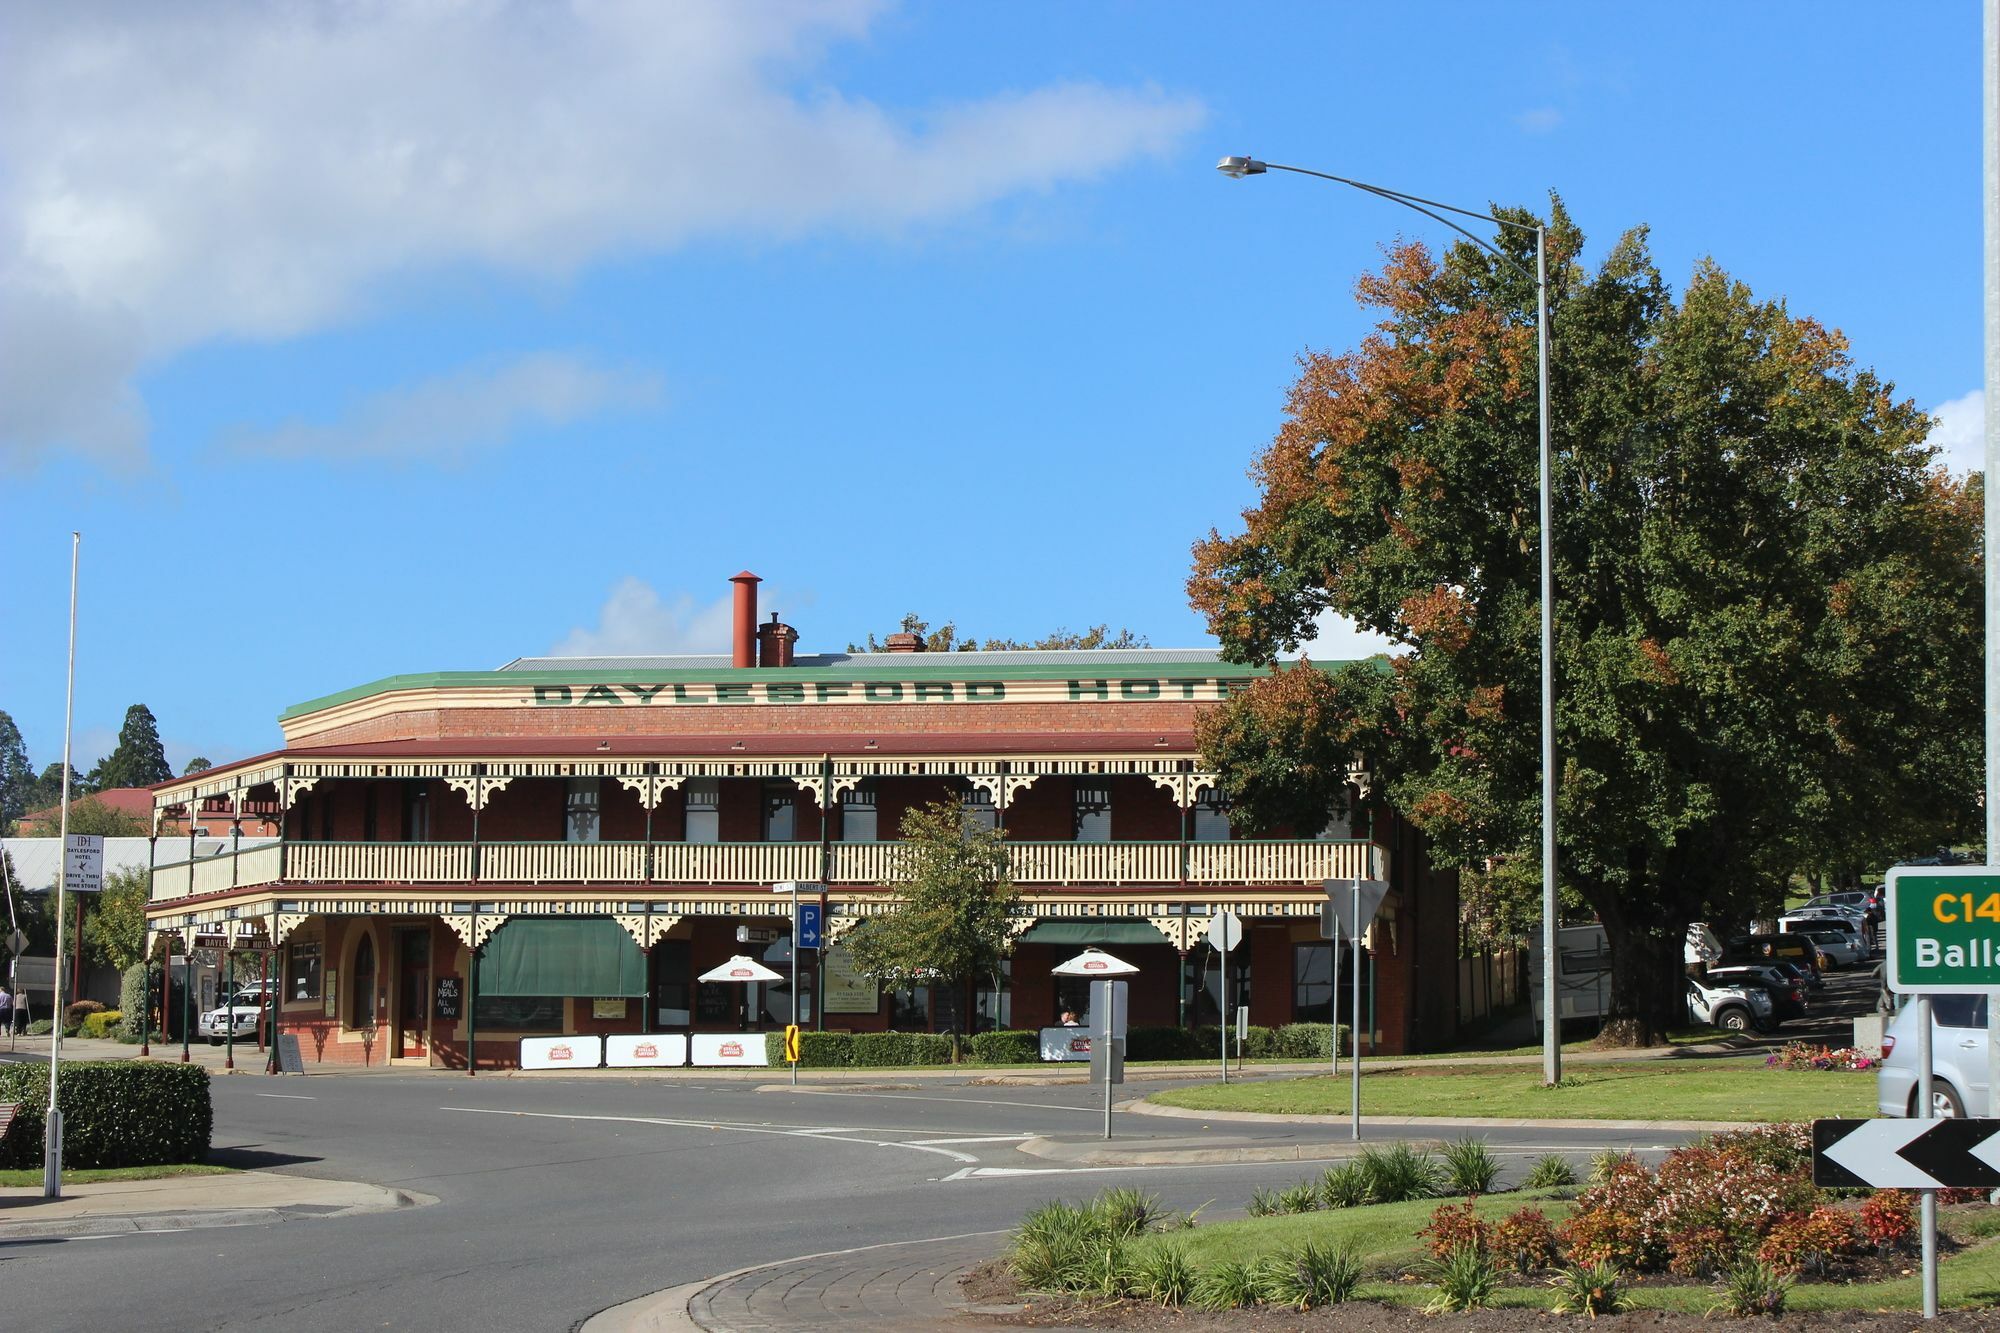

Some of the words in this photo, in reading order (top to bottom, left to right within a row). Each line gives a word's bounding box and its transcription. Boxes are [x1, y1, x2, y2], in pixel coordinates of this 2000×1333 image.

[533, 681, 1006, 705] DAYLESFORD
[1067, 678, 1253, 700] HOTE
[805, 912, 815, 924] P
[1916, 938, 2000, 968] Ball
[442, 980, 454, 988] BAR
[438, 988, 458, 998] MEALS
[438, 999, 448, 1007] ALL
[443, 1007, 456, 1015] DAY
